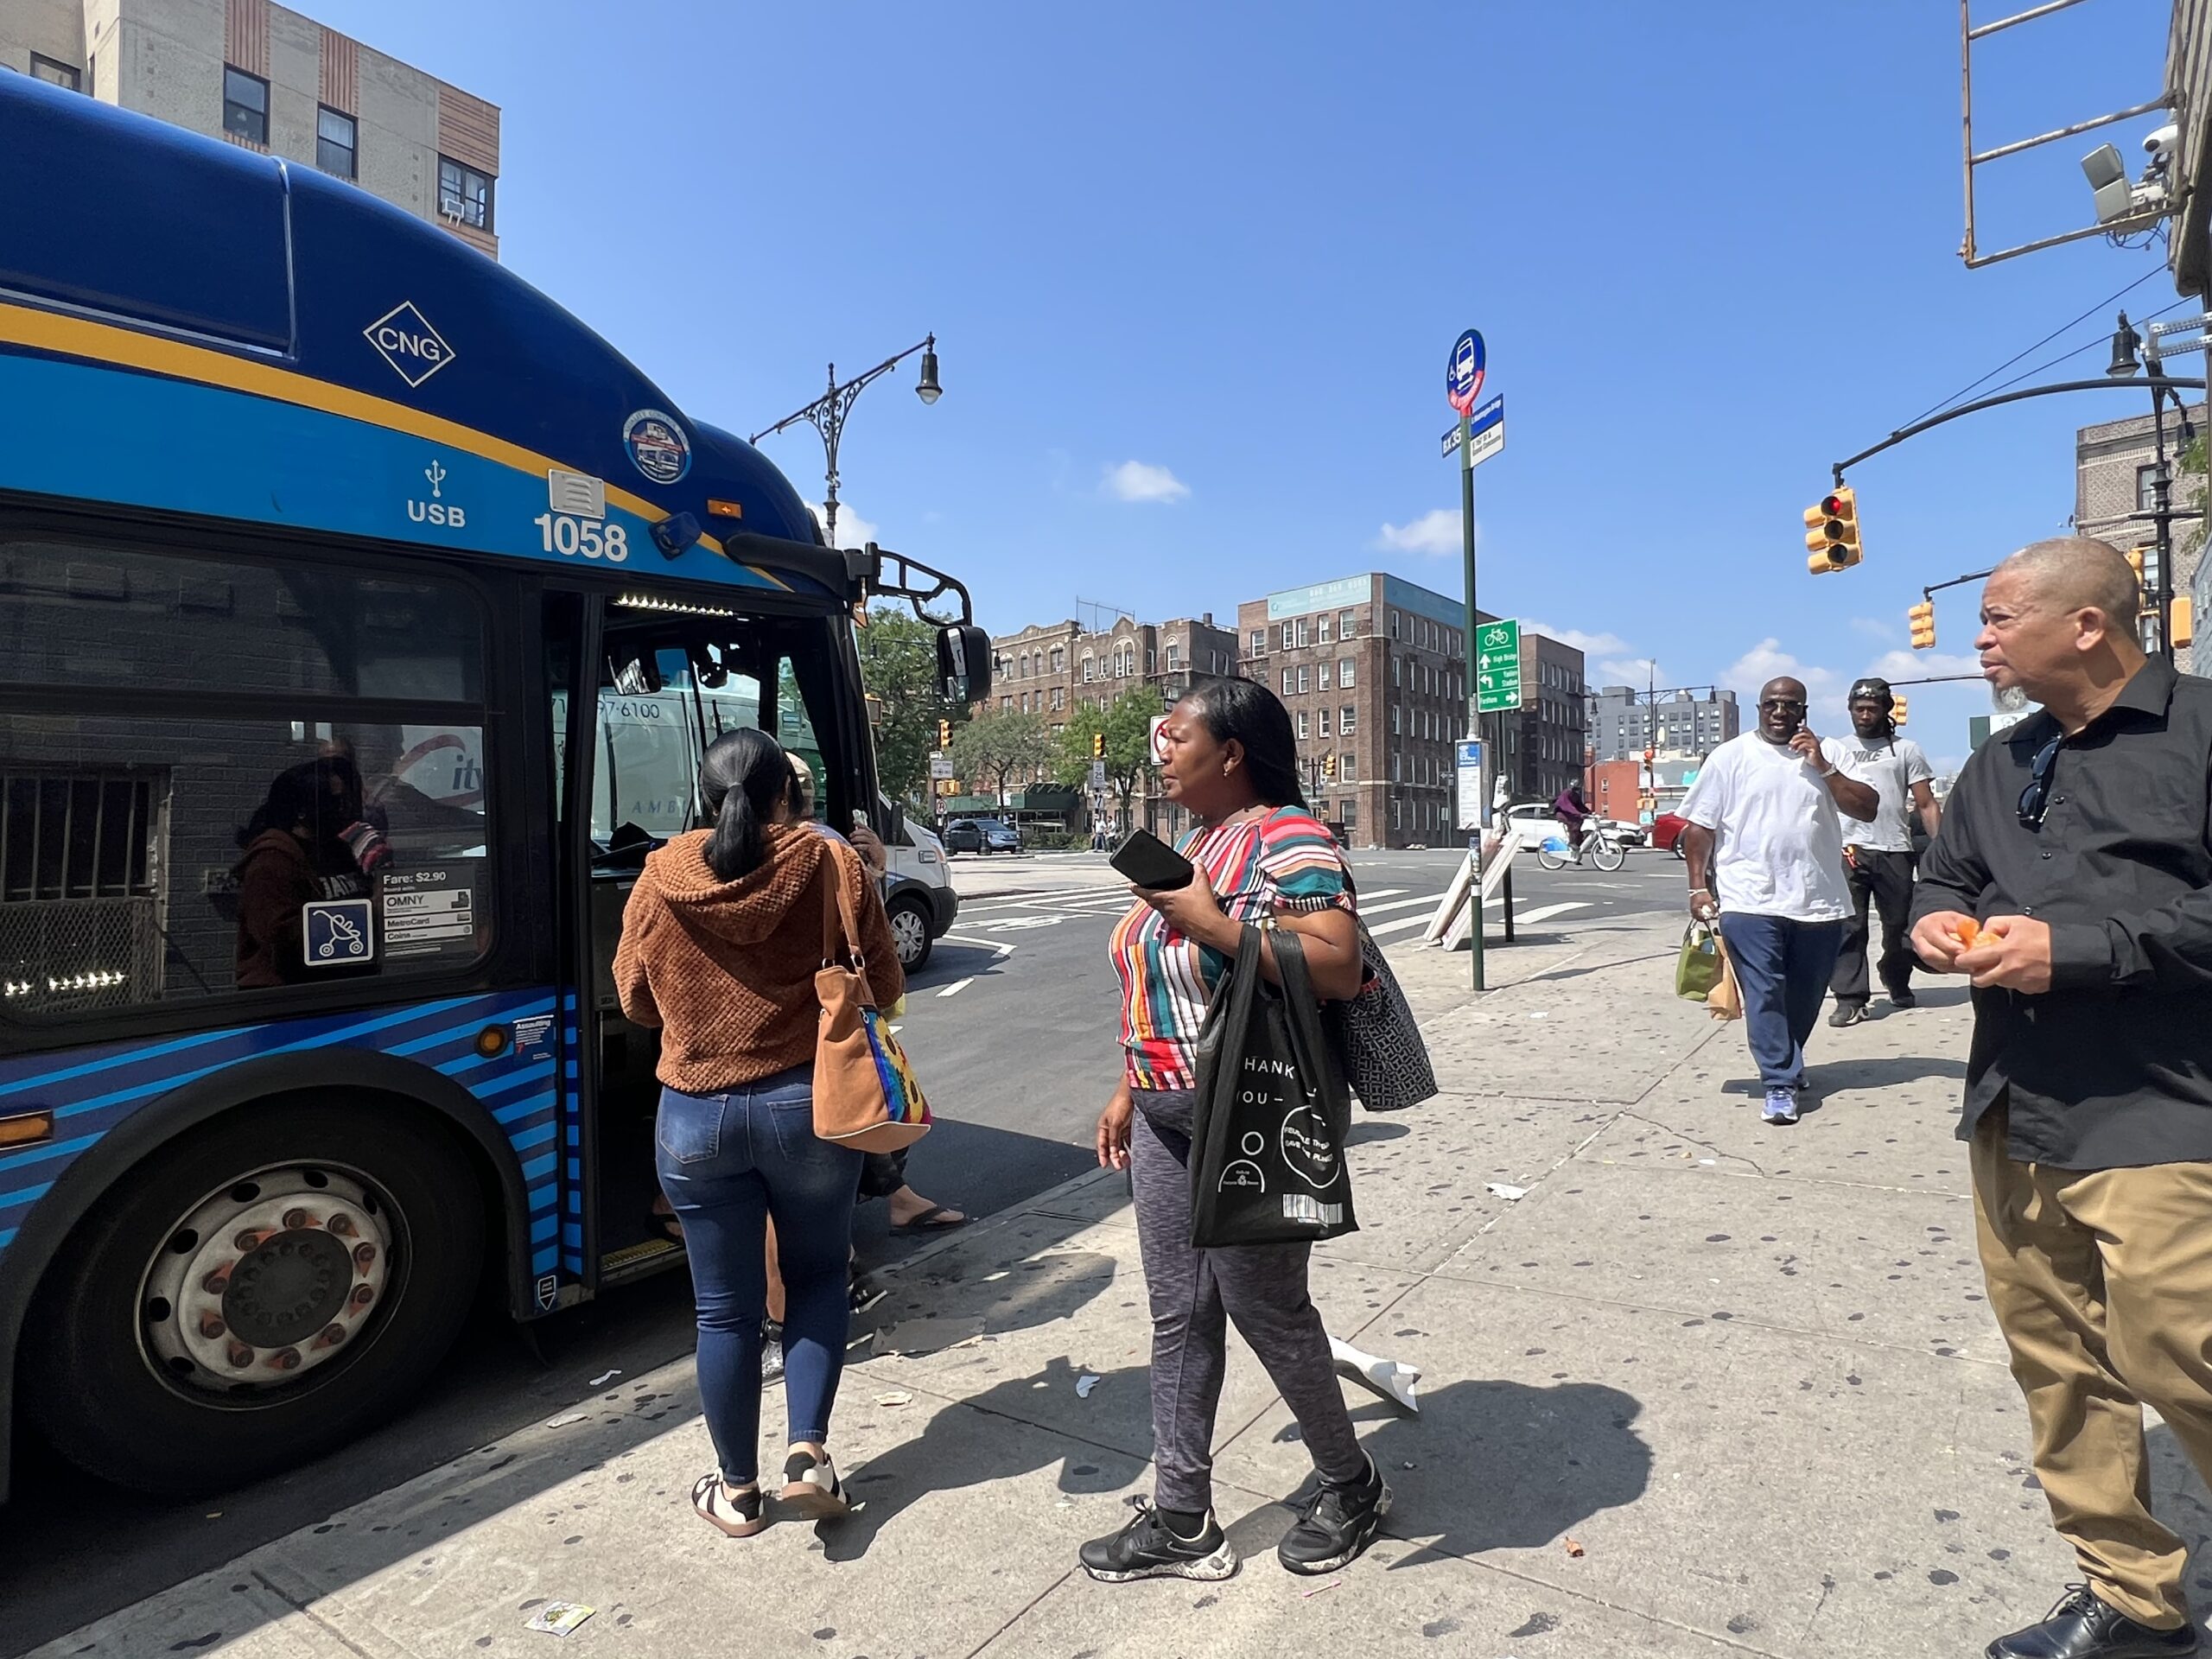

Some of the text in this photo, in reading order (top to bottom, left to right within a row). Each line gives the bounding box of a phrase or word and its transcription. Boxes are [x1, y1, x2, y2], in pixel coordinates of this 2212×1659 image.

[377, 327, 442, 362] CNG
[408, 500, 466, 528] USB
[534, 512, 628, 563] 1058
[1853, 750, 1883, 762] NIKE
[384, 872, 446, 885] Fare: $2.90
[386, 894, 424, 906] OMNY
[387, 918, 430, 927] MetroCard
[1244, 1057, 1294, 1079] HANK
